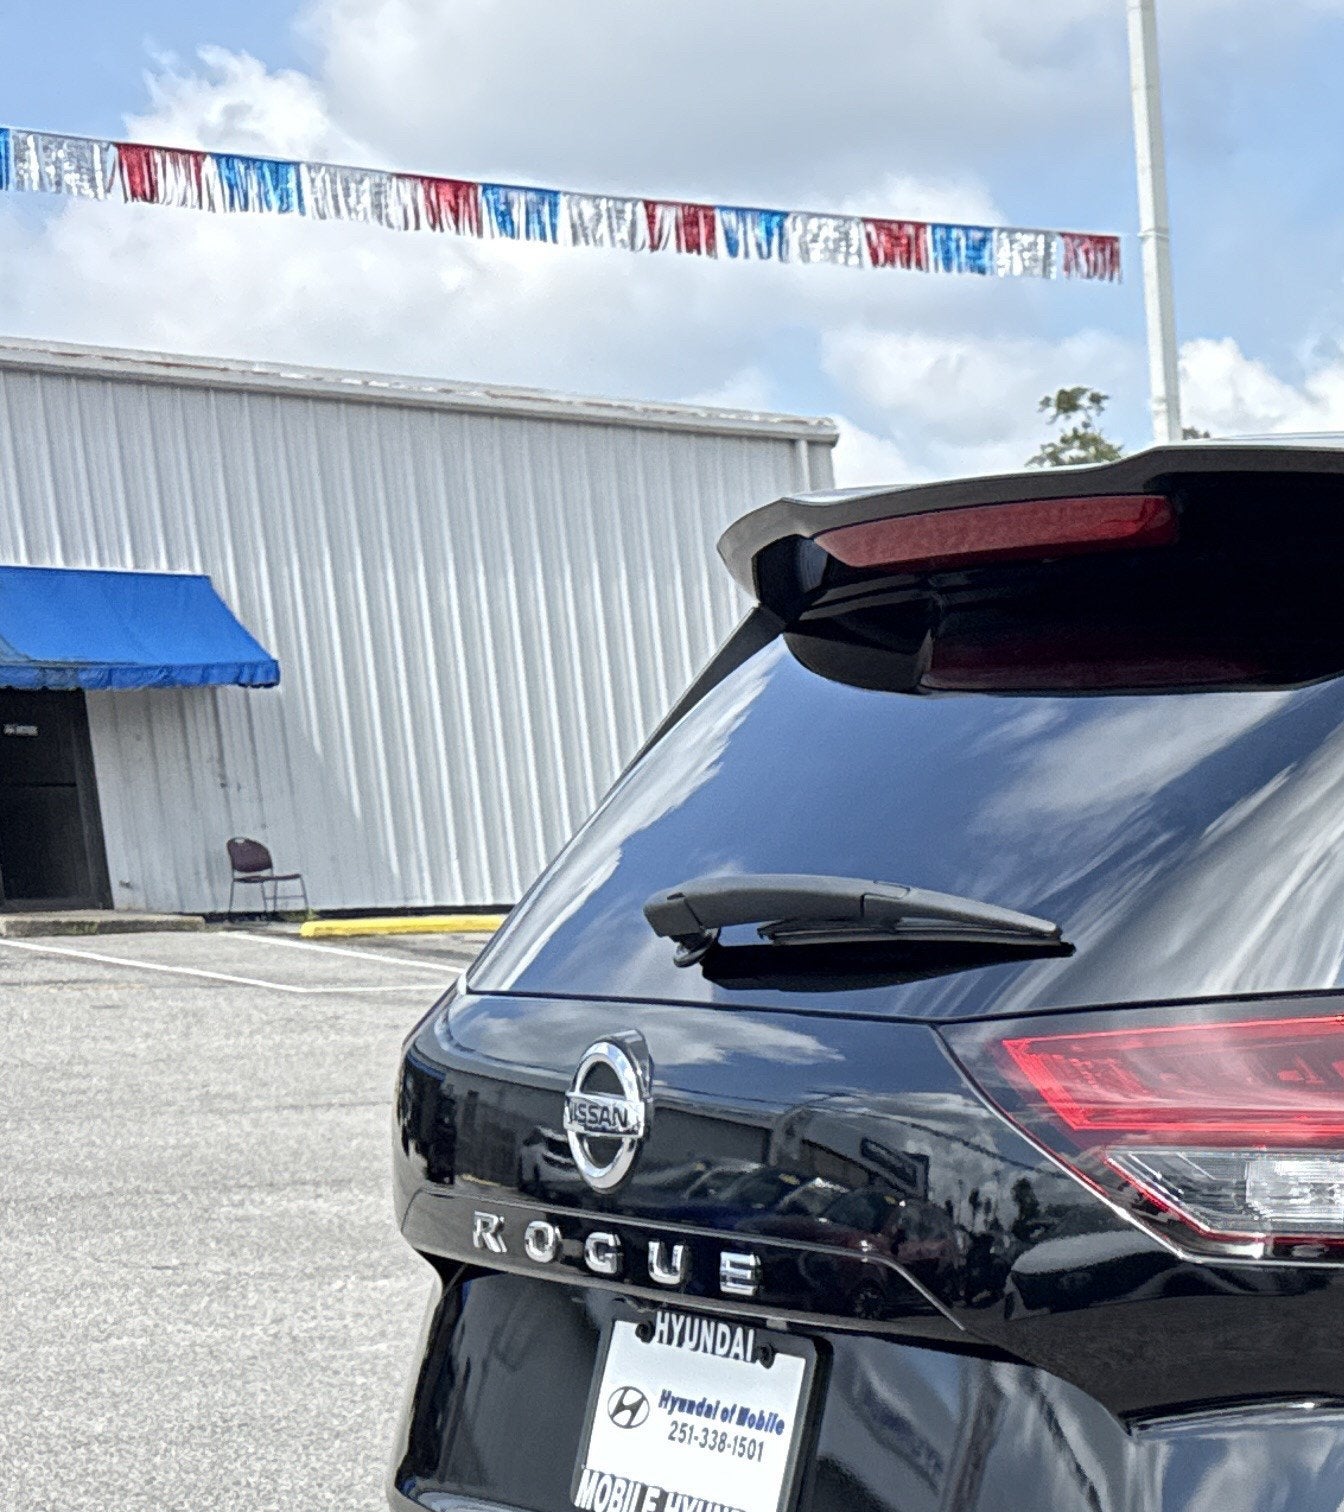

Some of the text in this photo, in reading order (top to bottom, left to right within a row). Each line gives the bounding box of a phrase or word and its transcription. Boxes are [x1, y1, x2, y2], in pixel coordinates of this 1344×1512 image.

[472, 1210, 762, 1297] ROGUE
[654, 1310, 756, 1363] HYUNDAI
[658, 1389, 786, 1436] Hyundai of Mobile
[668, 1420, 765, 1462] 251-338-1501
